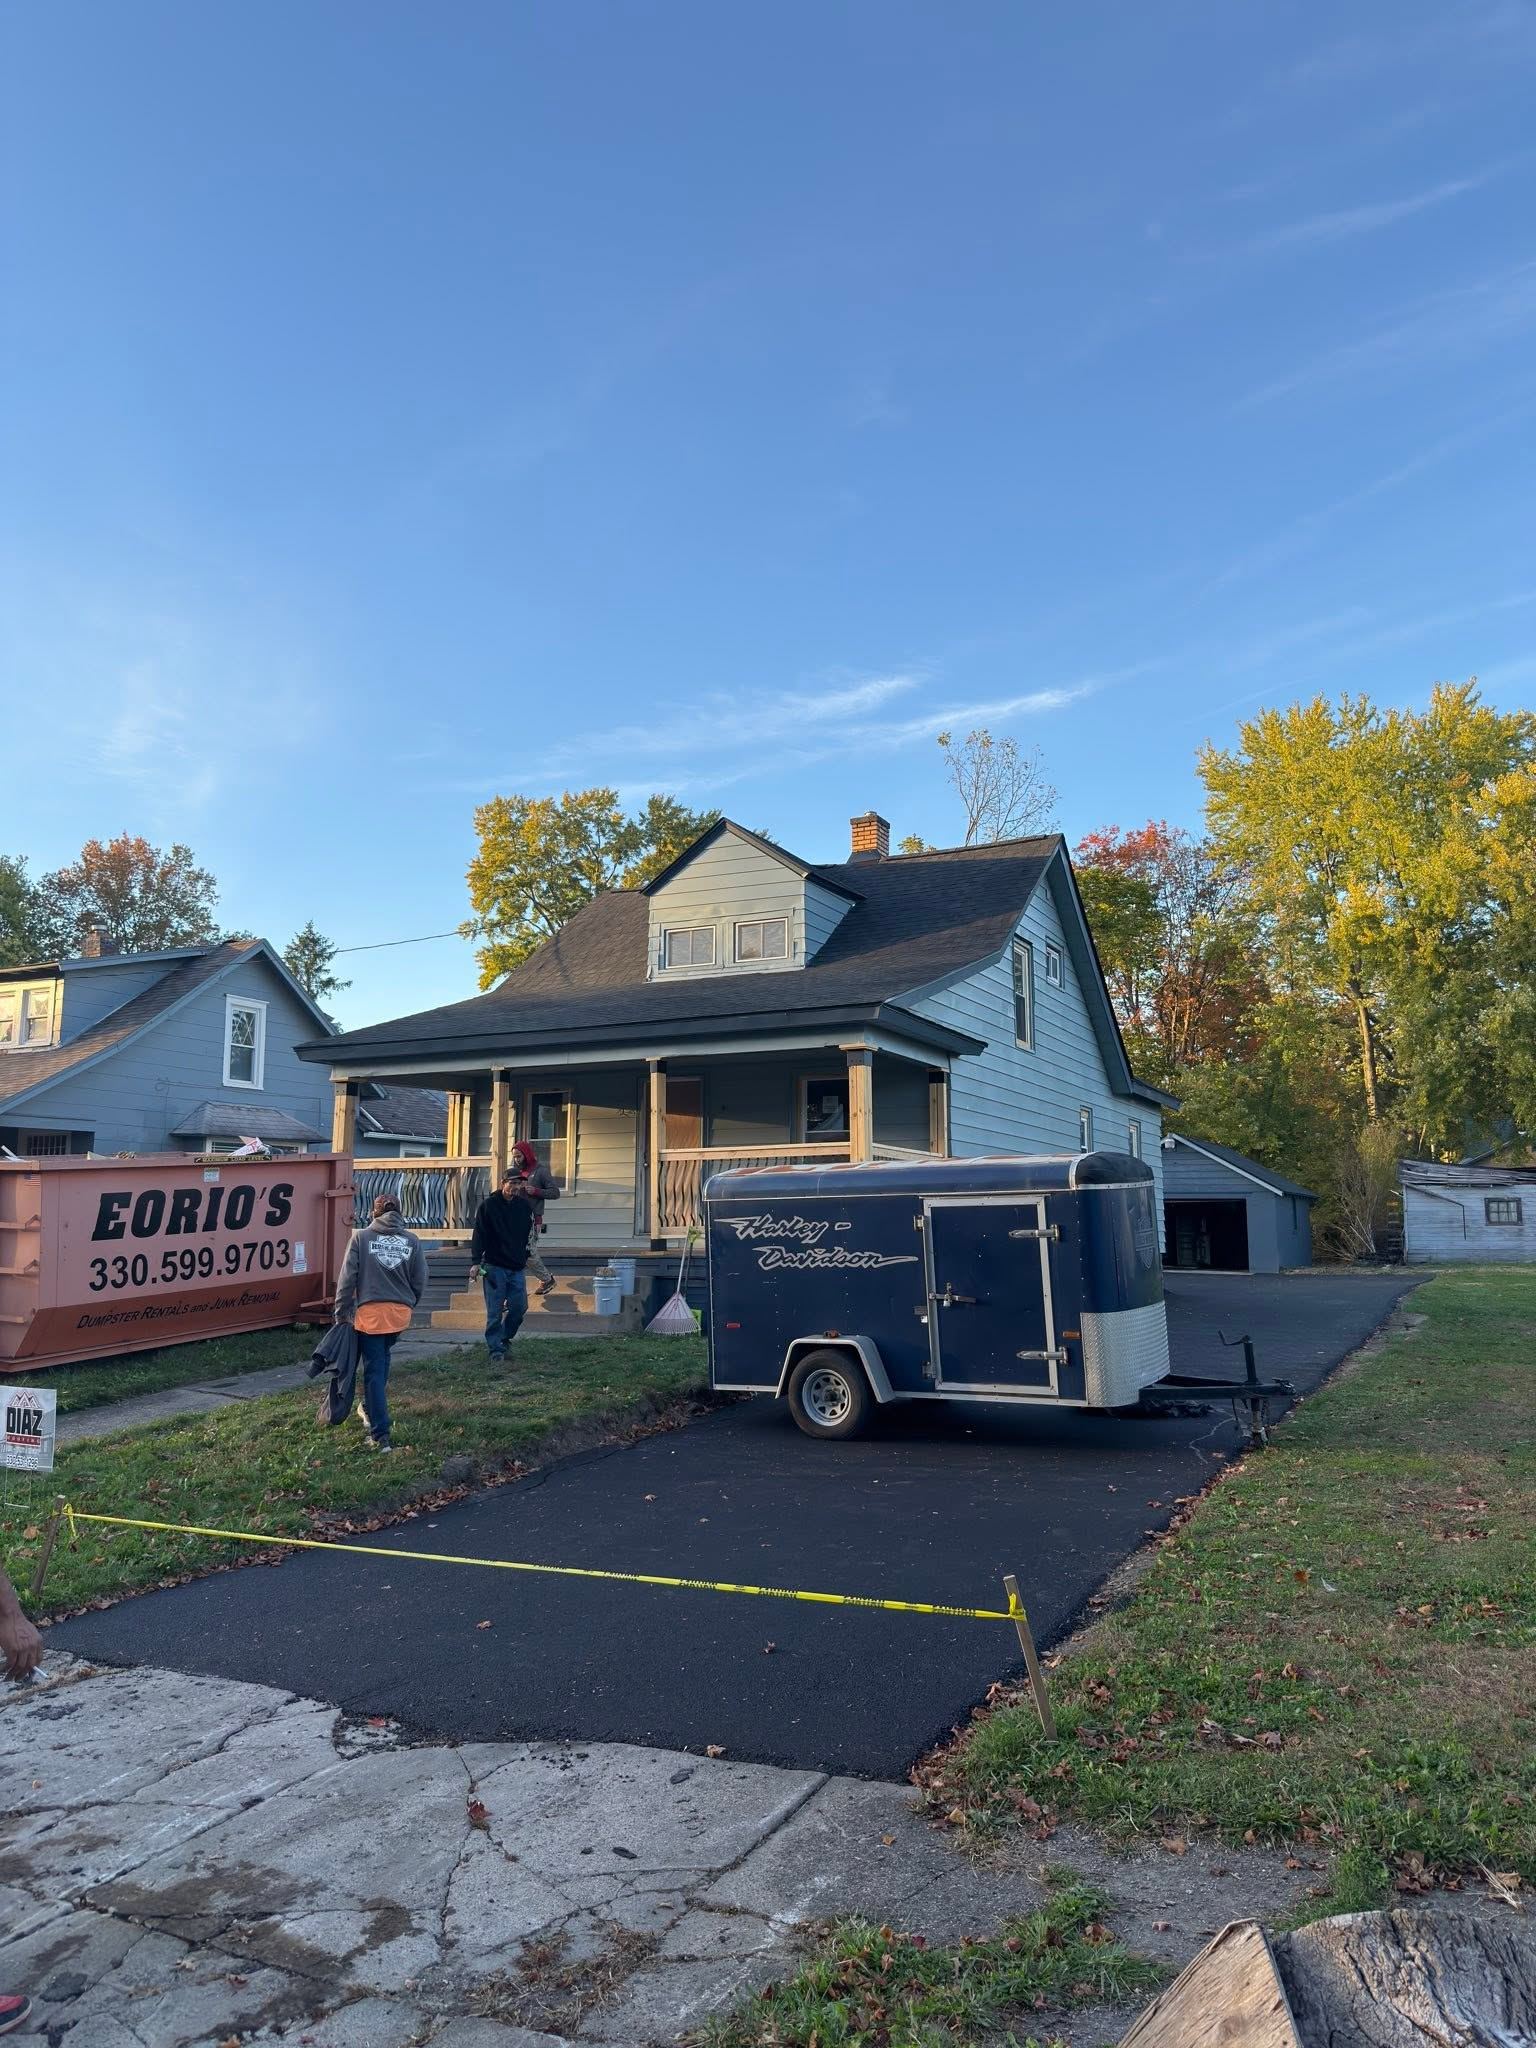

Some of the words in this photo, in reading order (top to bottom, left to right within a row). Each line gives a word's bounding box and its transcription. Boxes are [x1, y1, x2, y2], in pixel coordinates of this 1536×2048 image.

[91, 1183, 295, 1242] EORIO'S
[88, 1238, 291, 1292] 330.599.9703
[752, 1246, 919, 1271] Davidson
[76, 1310, 142, 1329] DUMPSTER
[140, 1303, 190, 1320] RENTALS
[209, 1297, 240, 1310] JUNK
[237, 1291, 281, 1306] REMOVAL
[6, 1406, 44, 1436] DIAZ
